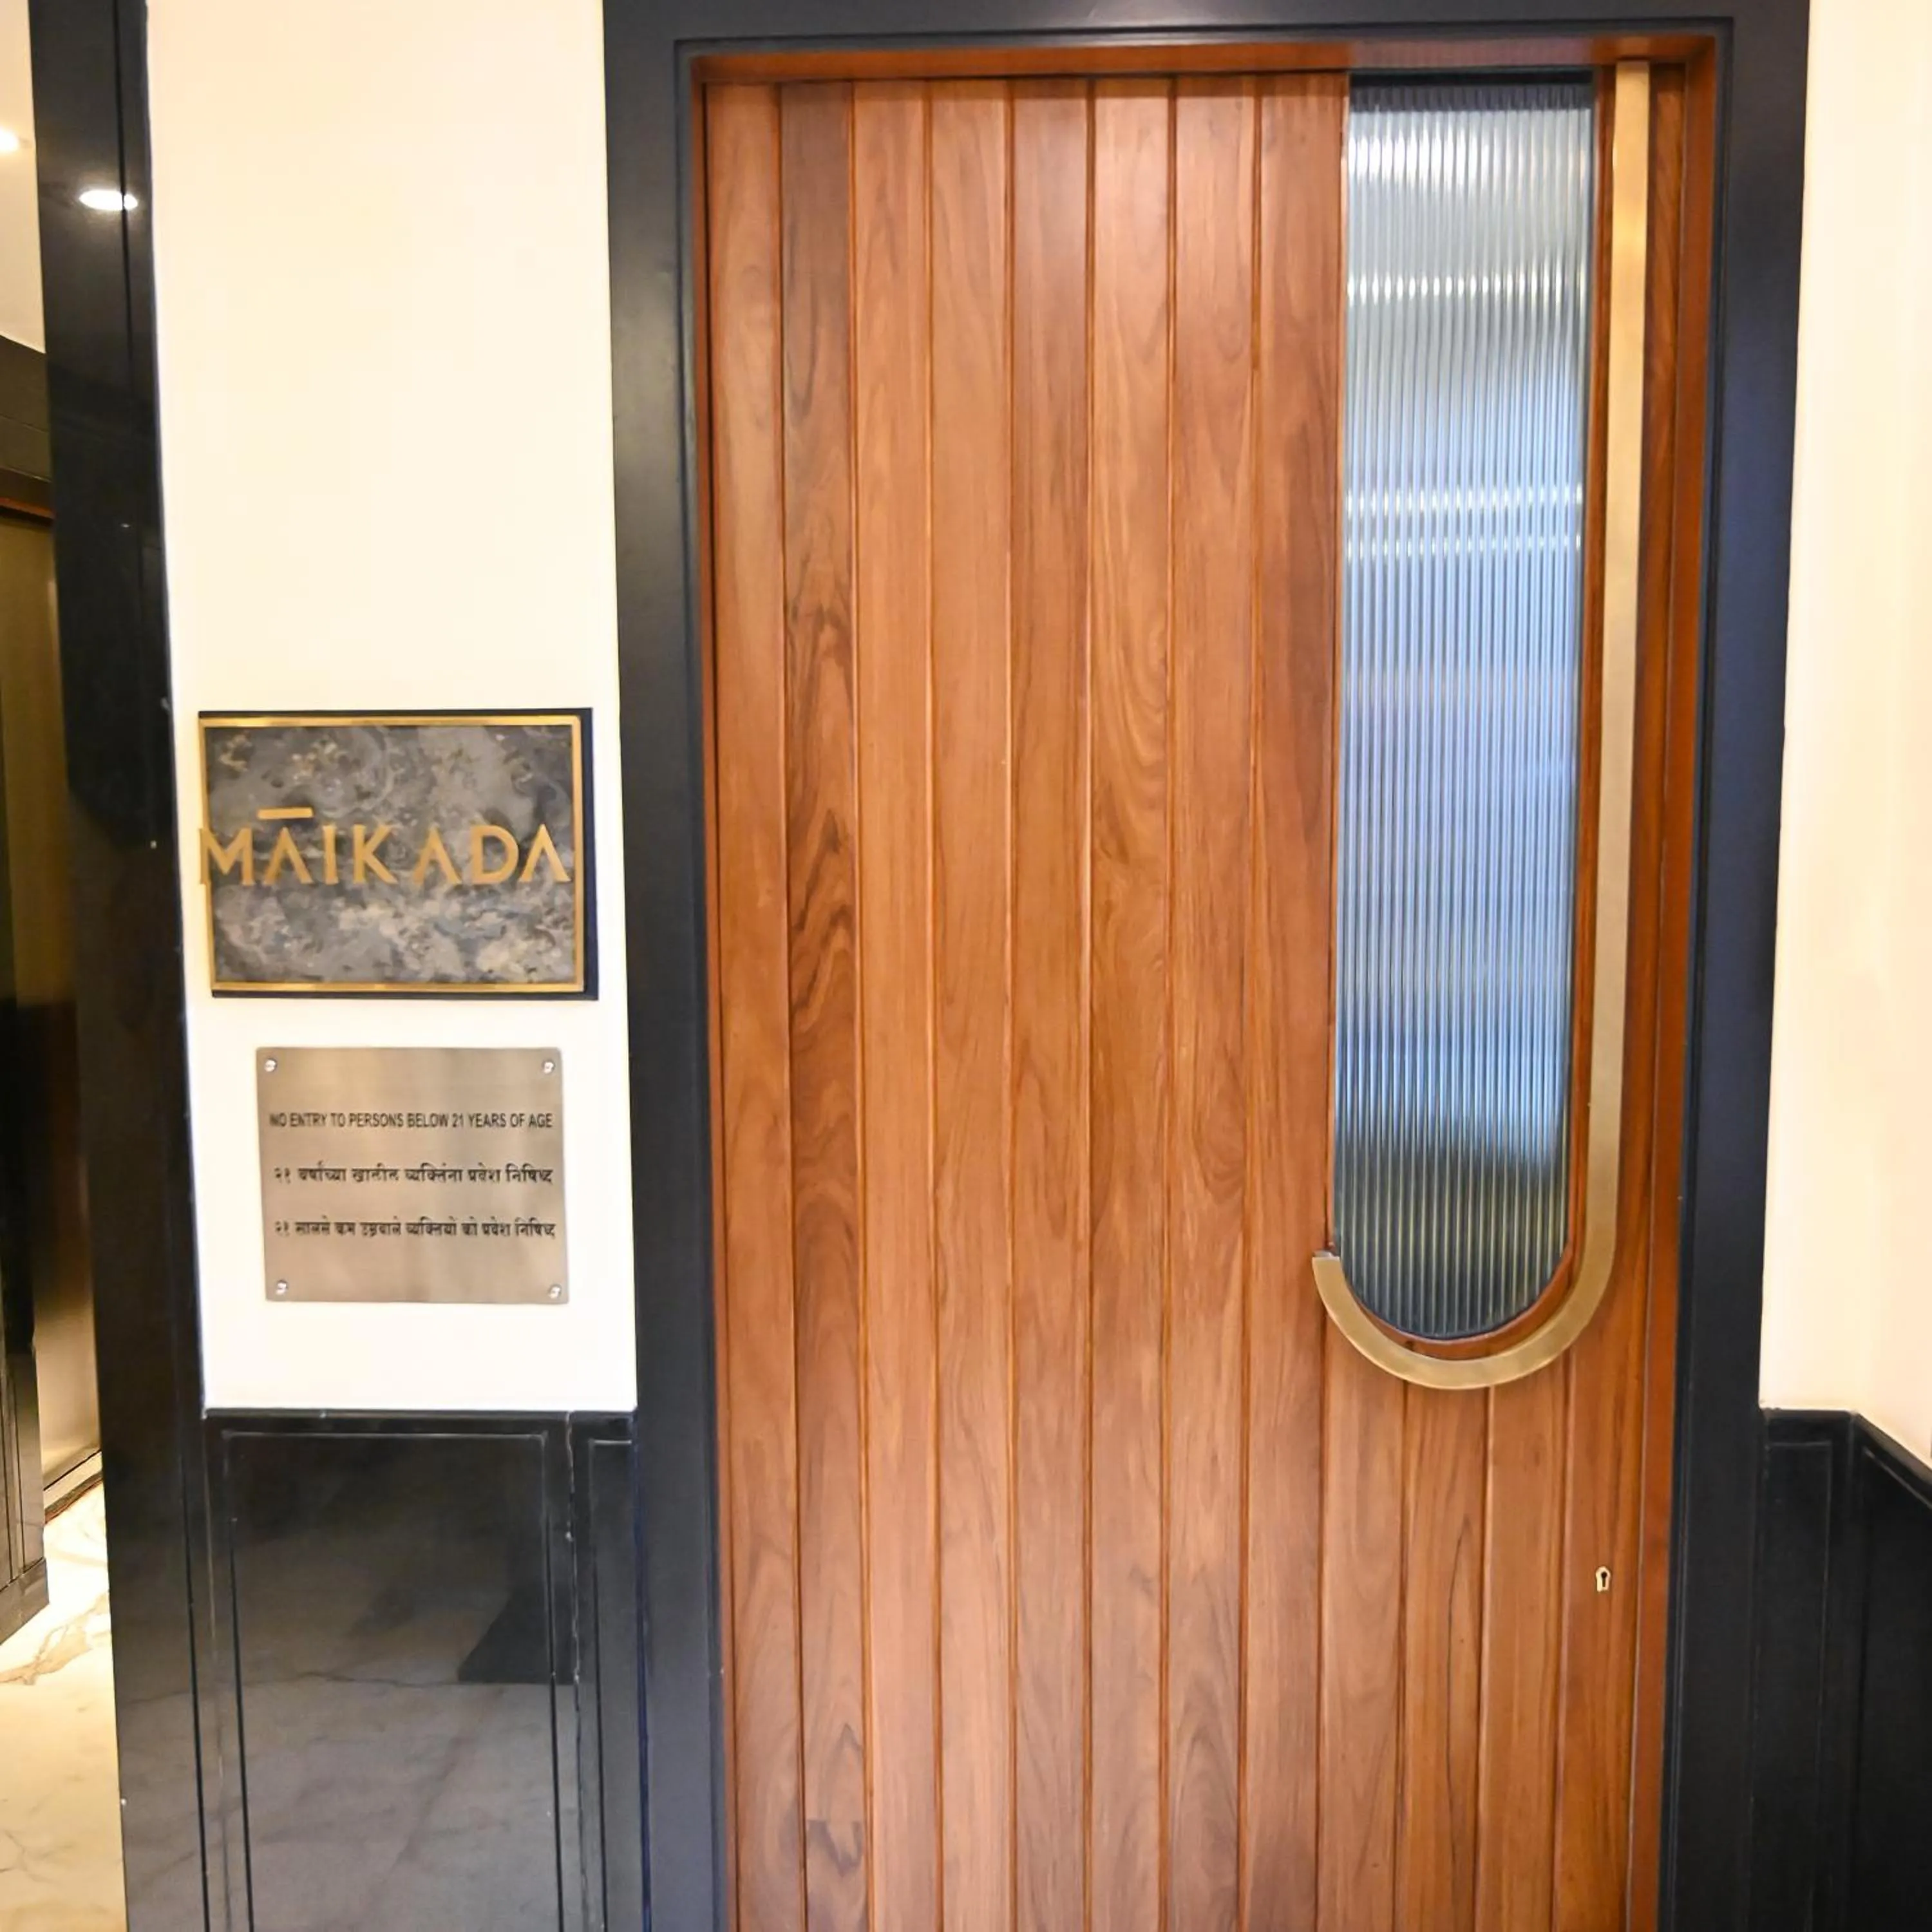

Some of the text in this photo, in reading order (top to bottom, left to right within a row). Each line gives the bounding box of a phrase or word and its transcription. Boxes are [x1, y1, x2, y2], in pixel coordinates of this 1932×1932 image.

[269, 1112, 553, 1128] NO ENTRY TO PERSONS BELOW 21 YEARS OF AGE
